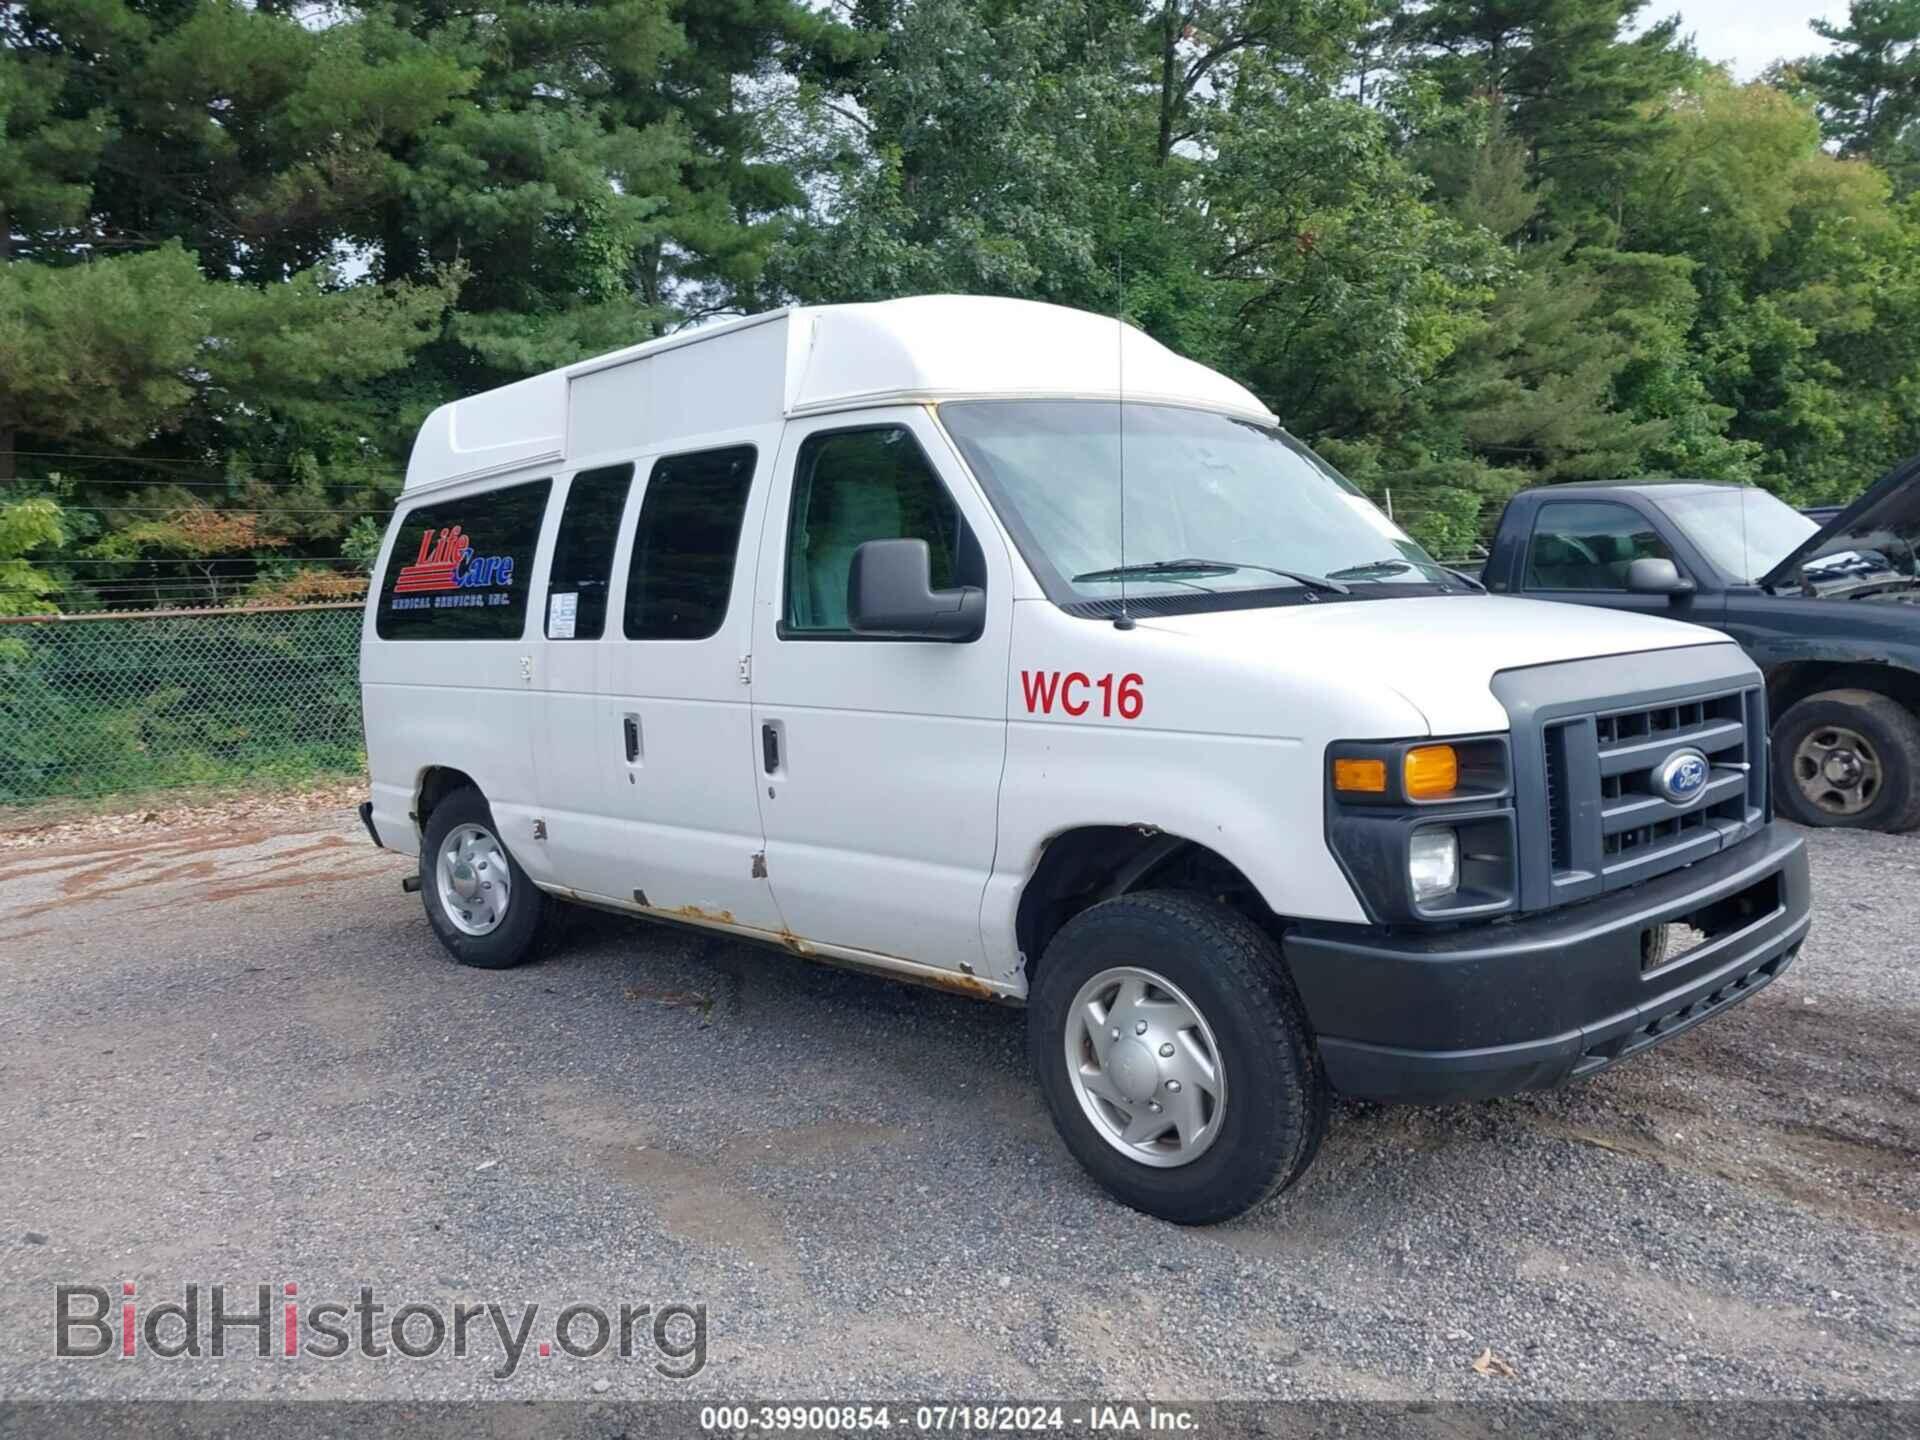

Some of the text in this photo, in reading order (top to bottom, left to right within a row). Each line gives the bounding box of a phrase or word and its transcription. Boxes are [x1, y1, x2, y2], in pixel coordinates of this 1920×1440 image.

[416, 525, 470, 567] Life
[452, 547, 513, 587] Care
[392, 596, 431, 610] MEDICAL
[489, 593, 510, 606] INC.
[1020, 670, 1144, 720] WC16
[1678, 762, 1703, 788] Ford
